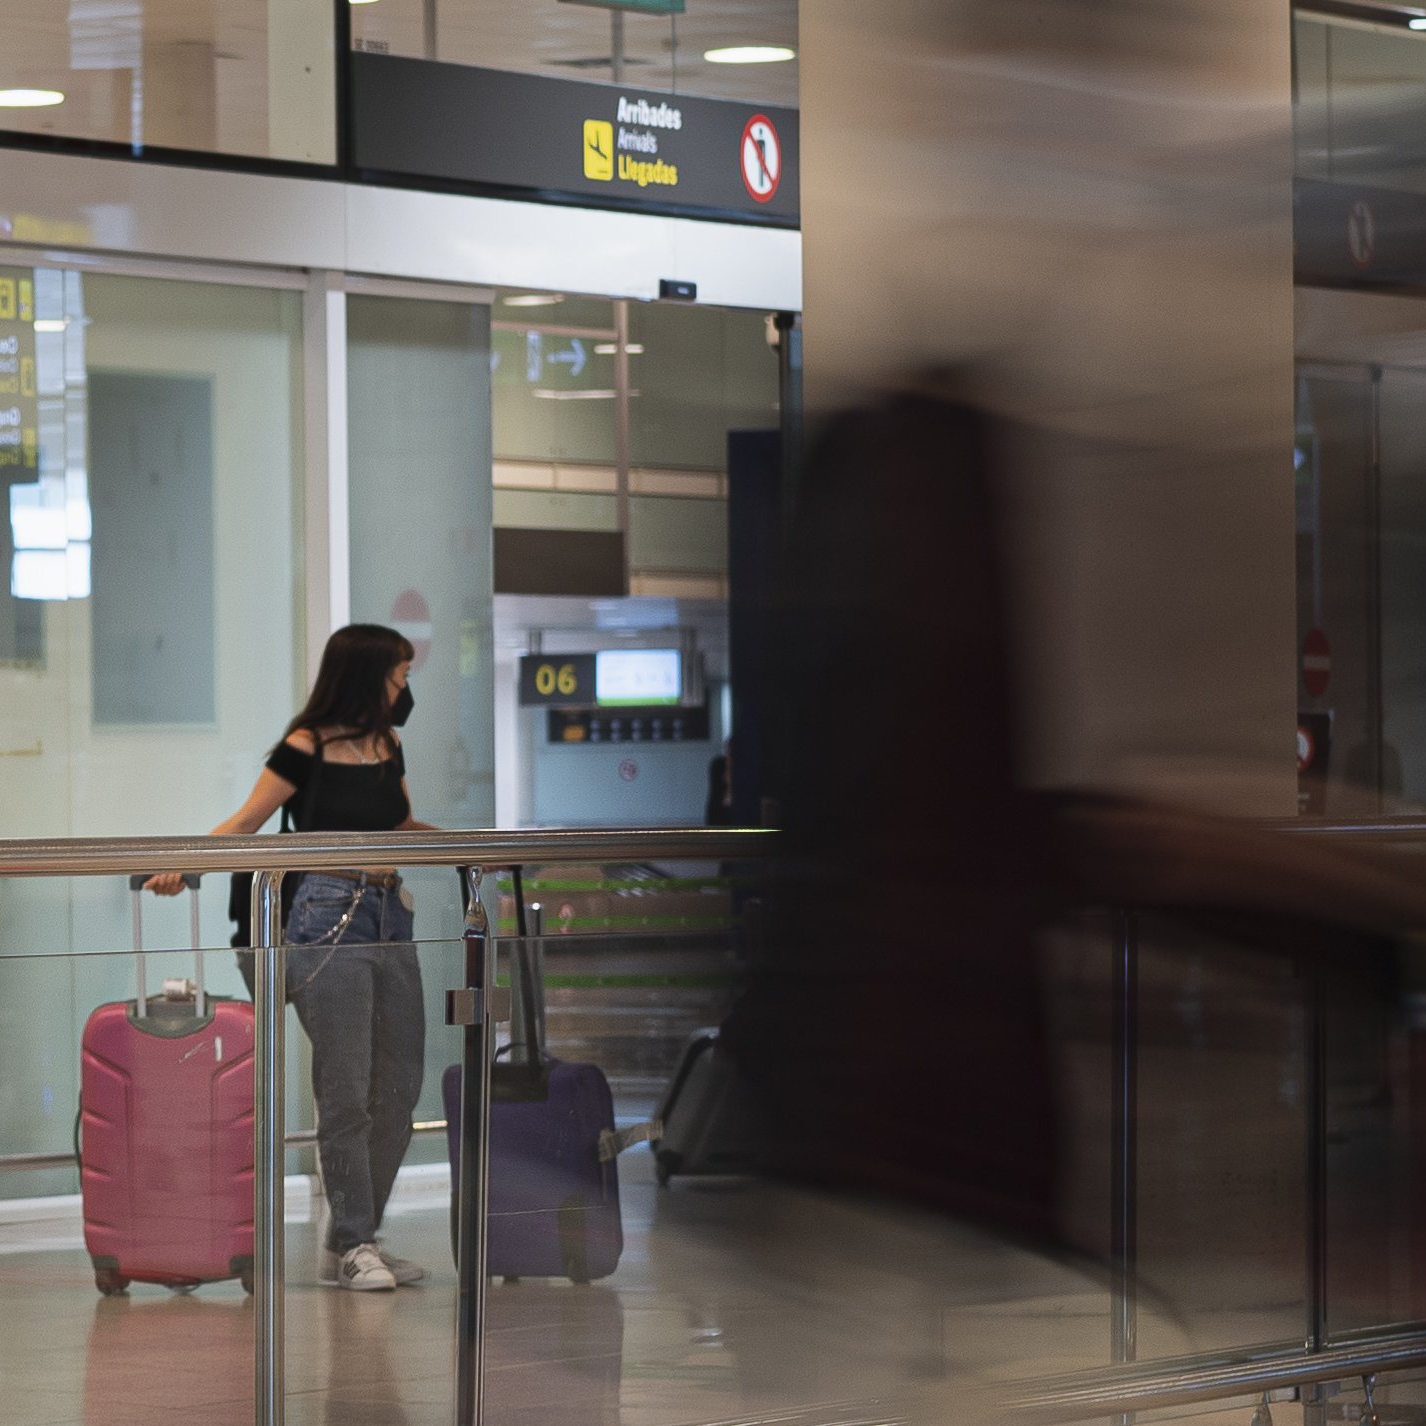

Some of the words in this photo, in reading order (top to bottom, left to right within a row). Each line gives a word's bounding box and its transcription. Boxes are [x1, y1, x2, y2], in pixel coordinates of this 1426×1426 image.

[617, 96, 682, 130] Arribades
[617, 126, 658, 154] Arrivals
[618, 153, 678, 187] Llegadas
[535, 664, 577, 695] 06
